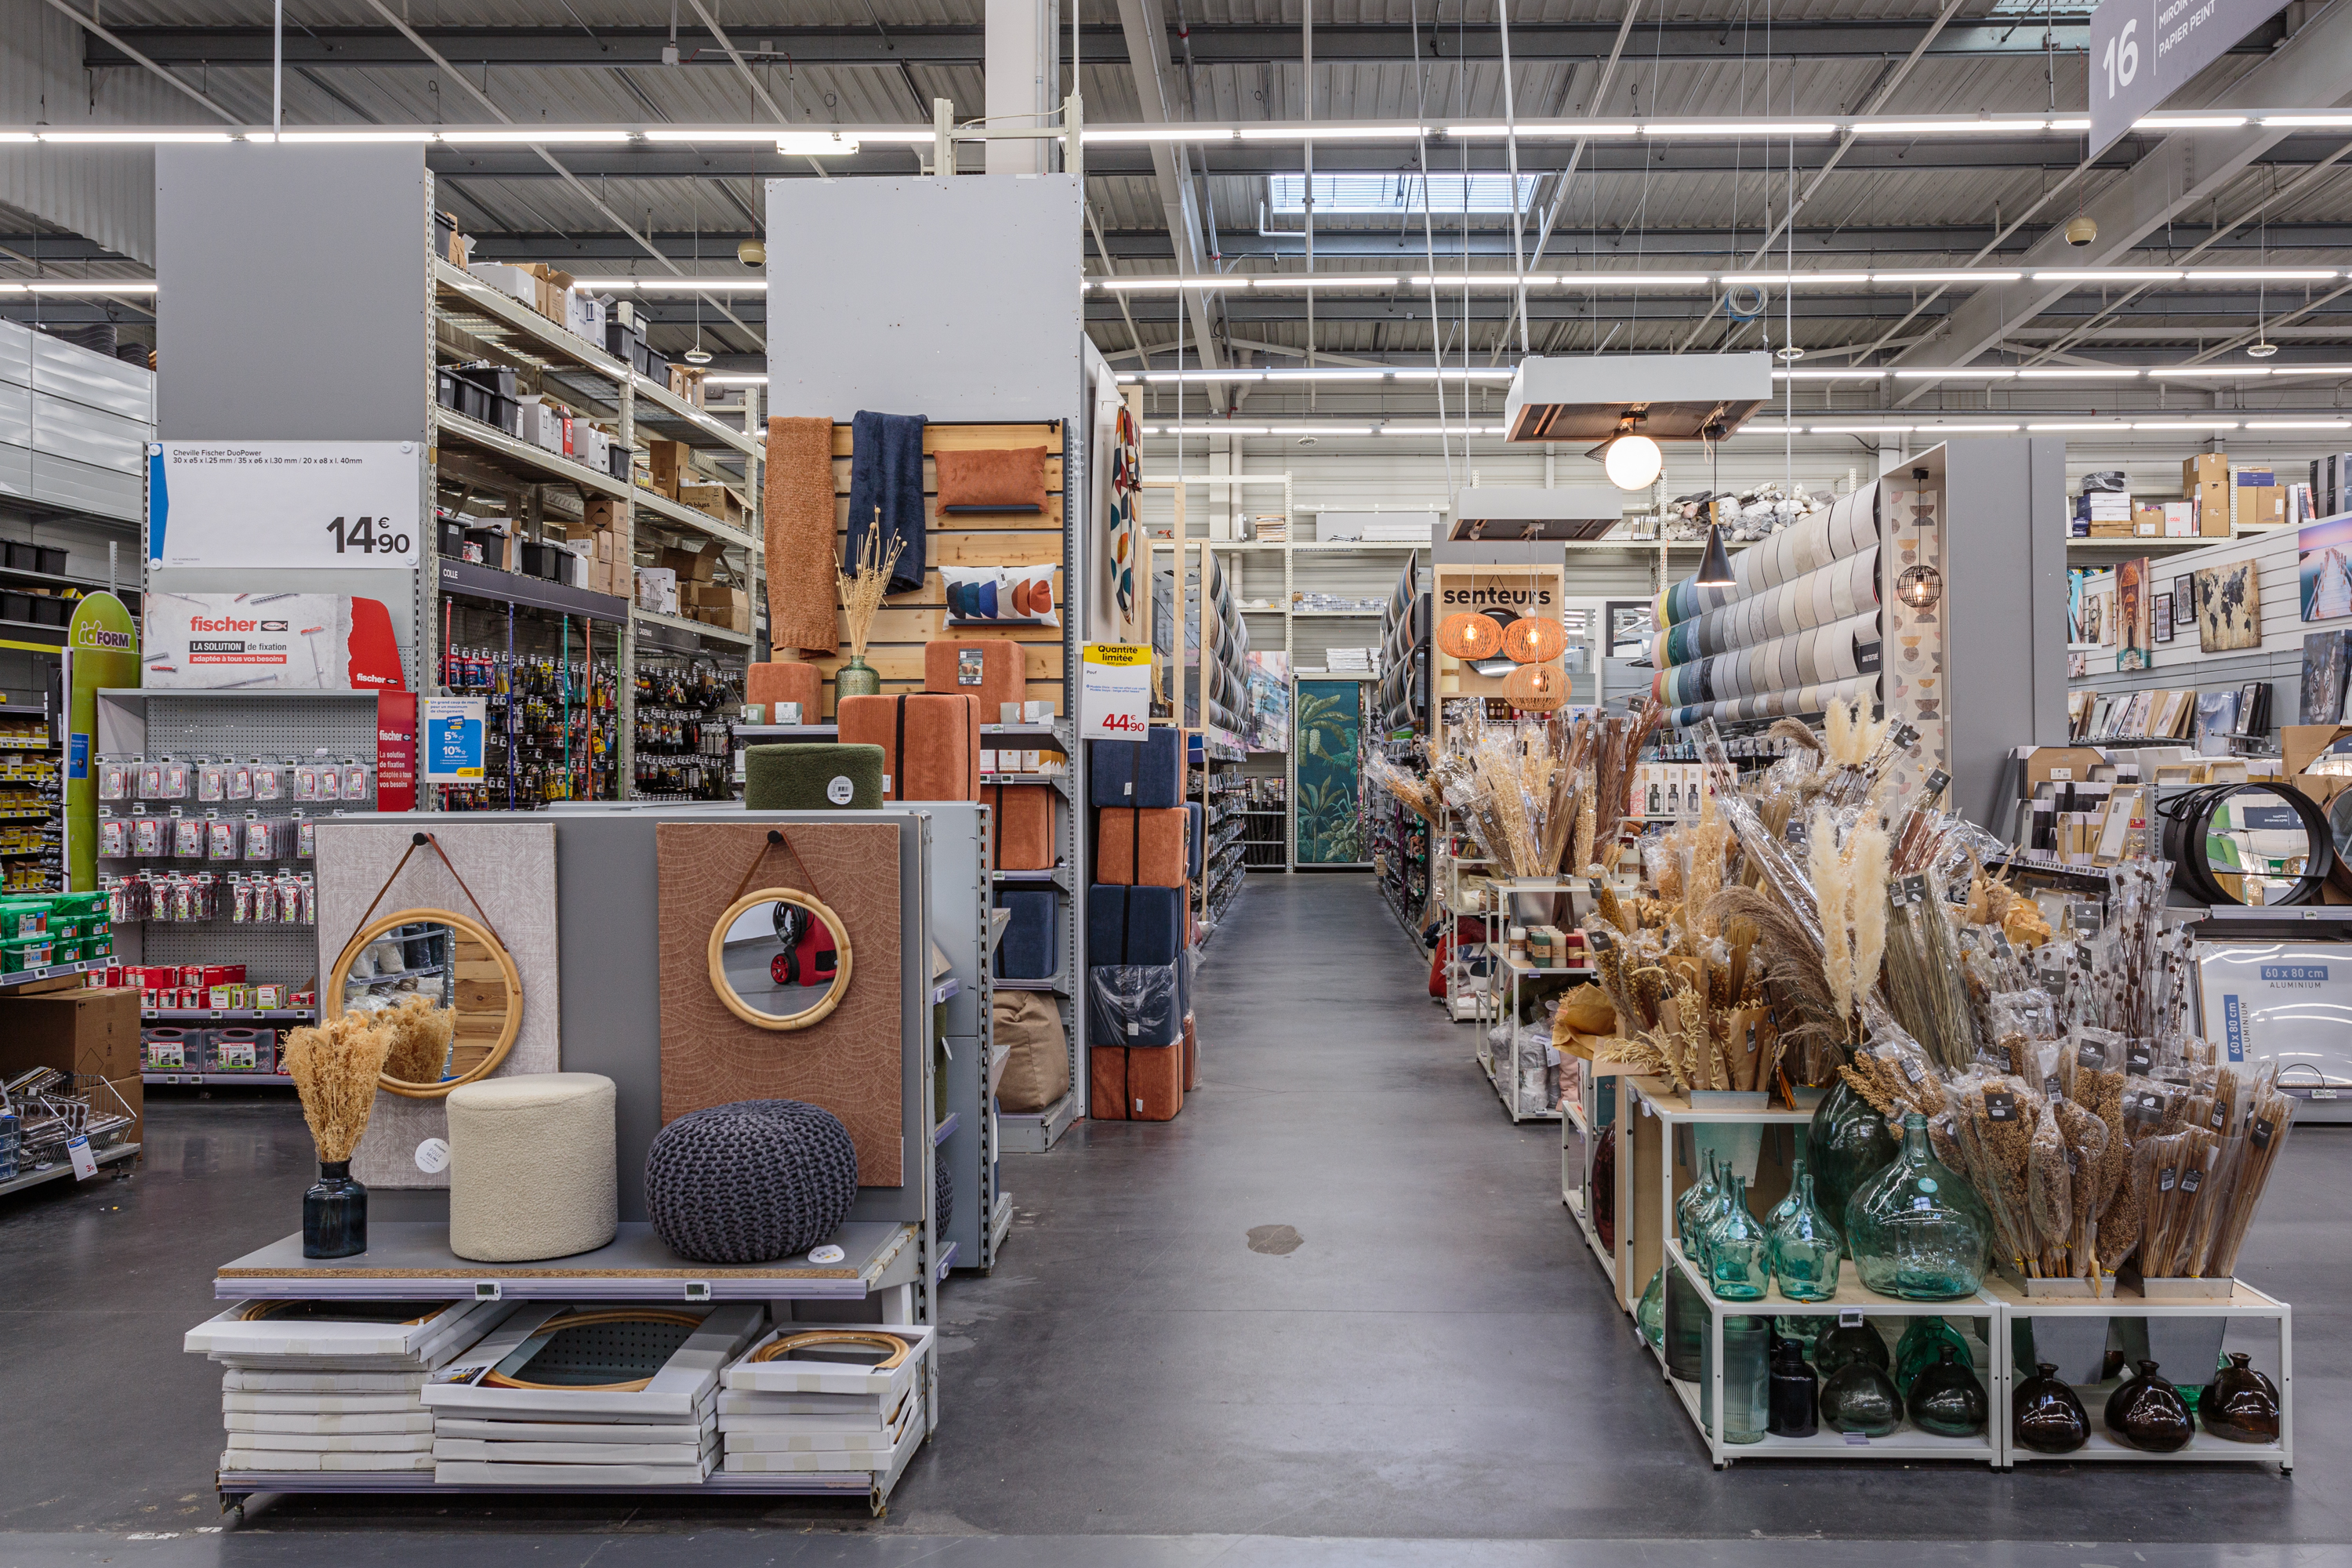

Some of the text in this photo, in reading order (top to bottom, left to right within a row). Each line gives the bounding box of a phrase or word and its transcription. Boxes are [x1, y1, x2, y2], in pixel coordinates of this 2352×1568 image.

[2159, 0, 2216, 57] PAPIER PEINT
[2102, 18, 2139, 100] 16
[326, 517, 377, 554] 14
[378, 534, 410, 554] 90
[443, 568, 459, 579] COLLE
[190, 616, 257, 632] fischer
[638, 627, 652, 637] CADENAS
[193, 643, 203, 652] LA
[204, 643, 241, 652] SOLUTION
[259, 643, 287, 652] fixation
[1098, 645, 1138, 654] Quantité
[193, 655, 220, 664] adaptée
[357, 673, 386, 684] fischer
[1102, 713, 1130, 731] 44
[1130, 722, 1145, 731] 90
[379, 730, 402, 741] fischer
[445, 731, 458, 740] 5%
[443, 746, 461, 755] 10%
[387, 760, 405, 768] fixation
[379, 770, 398, 779] adaptée
[2265, 968, 2278, 978] 60
[2291, 968, 2304, 978] 80
[2229, 1002, 2237, 1018] cm
[2229, 1020, 2238, 1033] 80
[2241, 1002, 2251, 1054] ALUMINIUM
[2230, 1043, 2240, 1054] 60
[426, 1152, 438, 1163] SELINA
[429, 1147, 443, 1158] POUF
